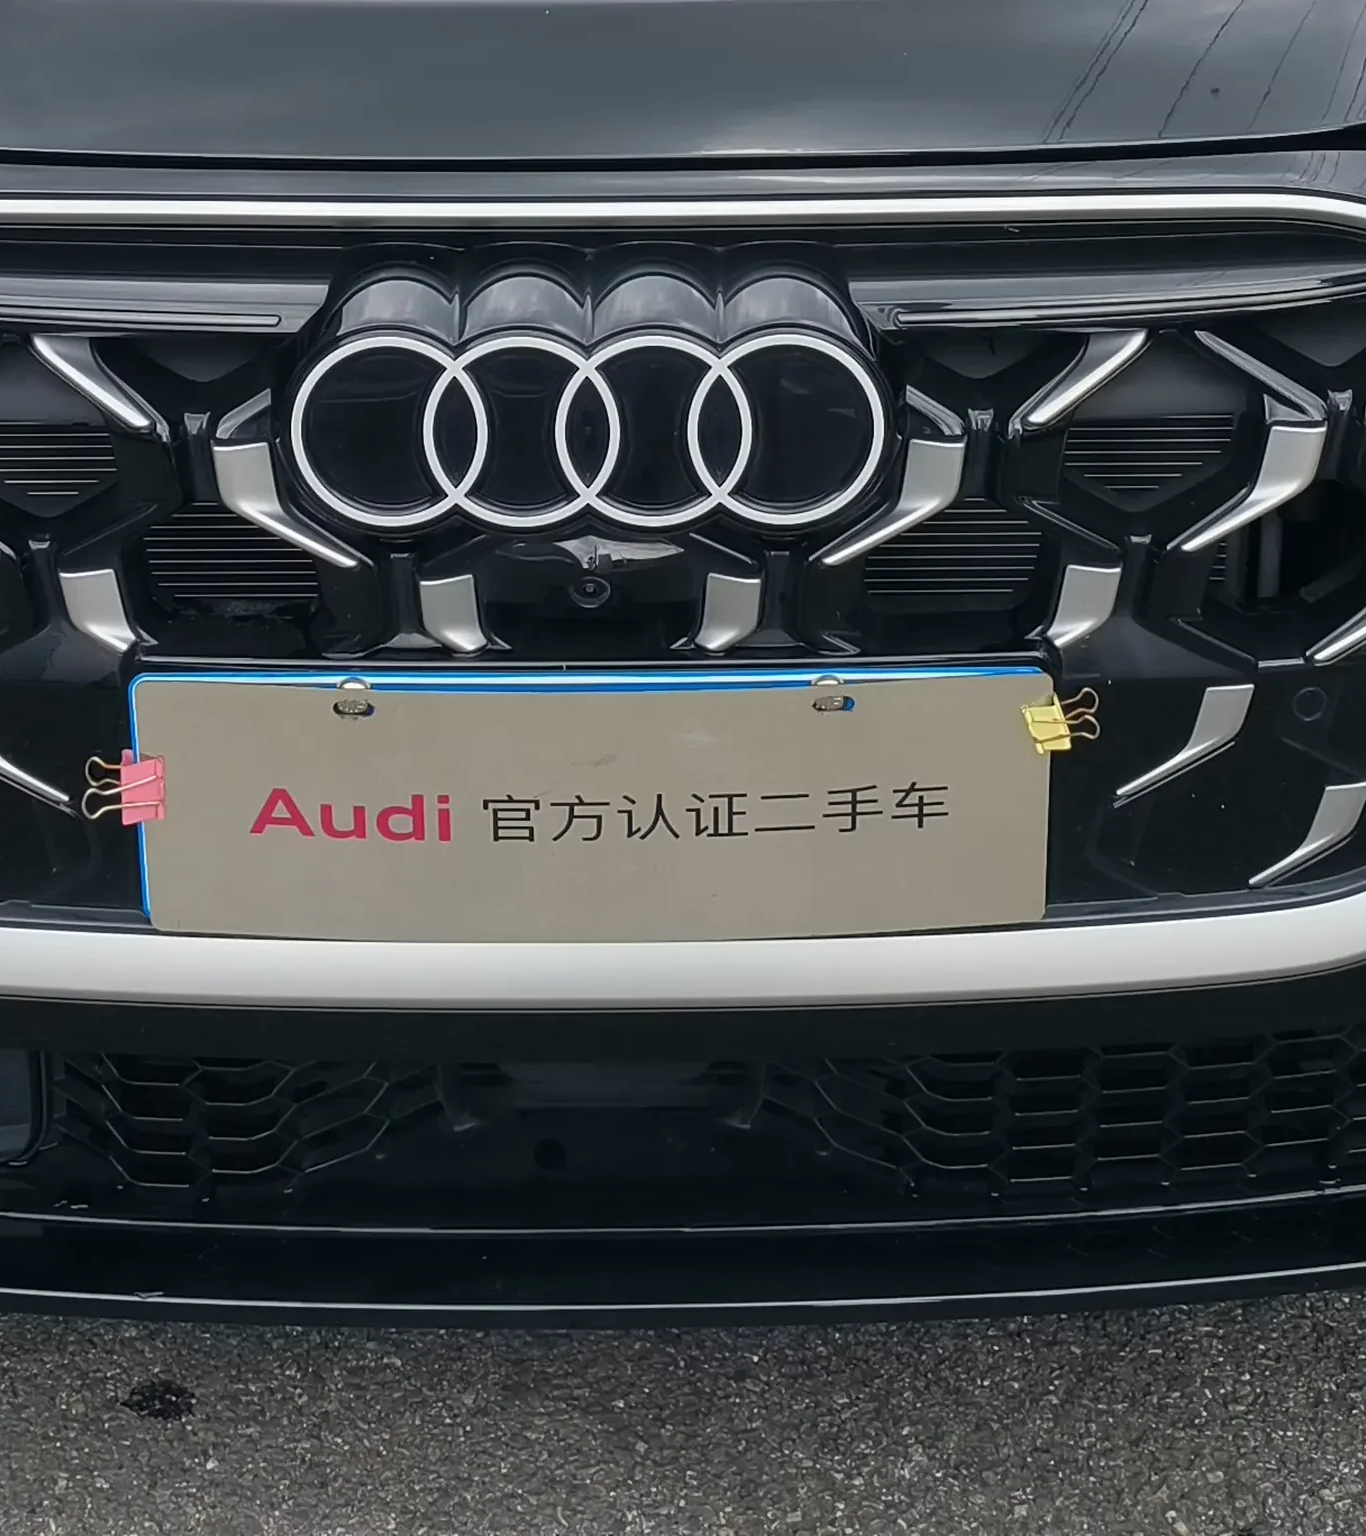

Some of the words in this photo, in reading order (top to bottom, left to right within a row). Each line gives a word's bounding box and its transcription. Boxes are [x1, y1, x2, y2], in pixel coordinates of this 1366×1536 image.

[250, 788, 451, 843] Audi
[481, 780, 951, 843] 官方认证二手车
